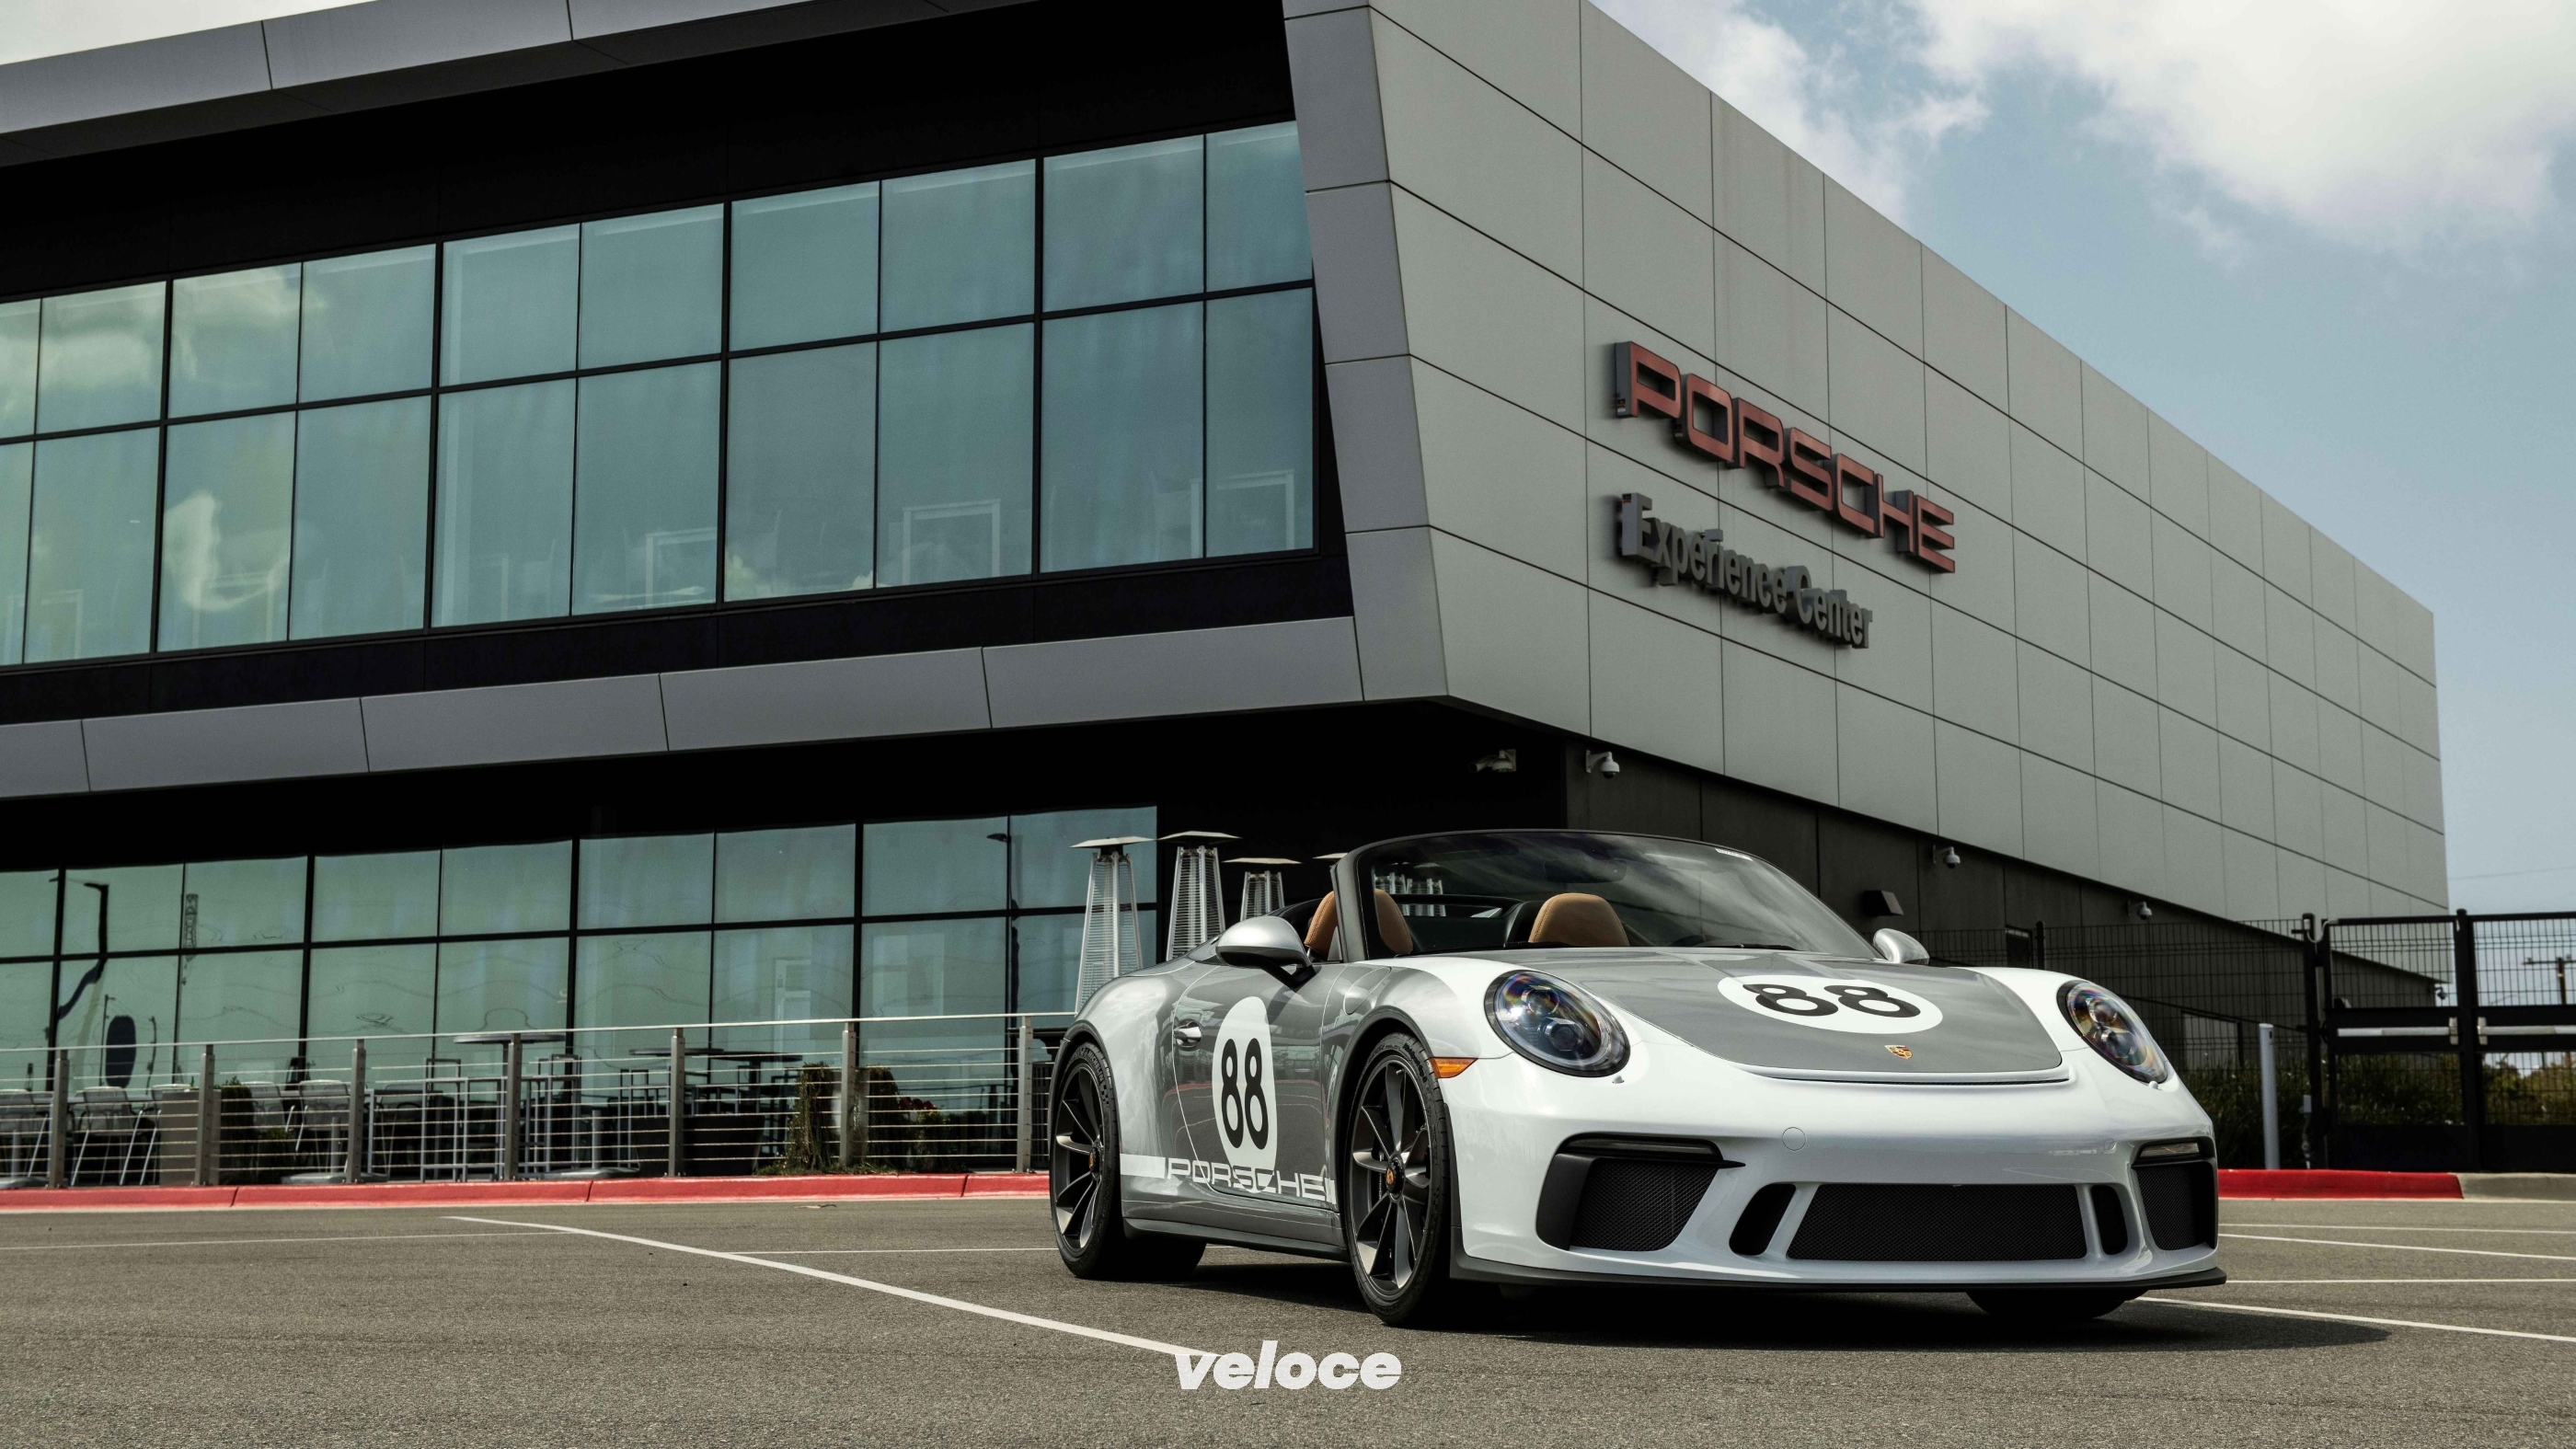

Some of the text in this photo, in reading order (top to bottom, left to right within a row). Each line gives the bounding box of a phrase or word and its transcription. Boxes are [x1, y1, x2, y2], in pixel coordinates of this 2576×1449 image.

[1616, 340, 1956, 573] PORSCHE
[1621, 492, 1873, 650] Experience Center
[1742, 983, 1922, 1018] 88
[1221, 1038, 1269, 1151] 88
[1167, 1157, 1328, 1202] PORSCHE
